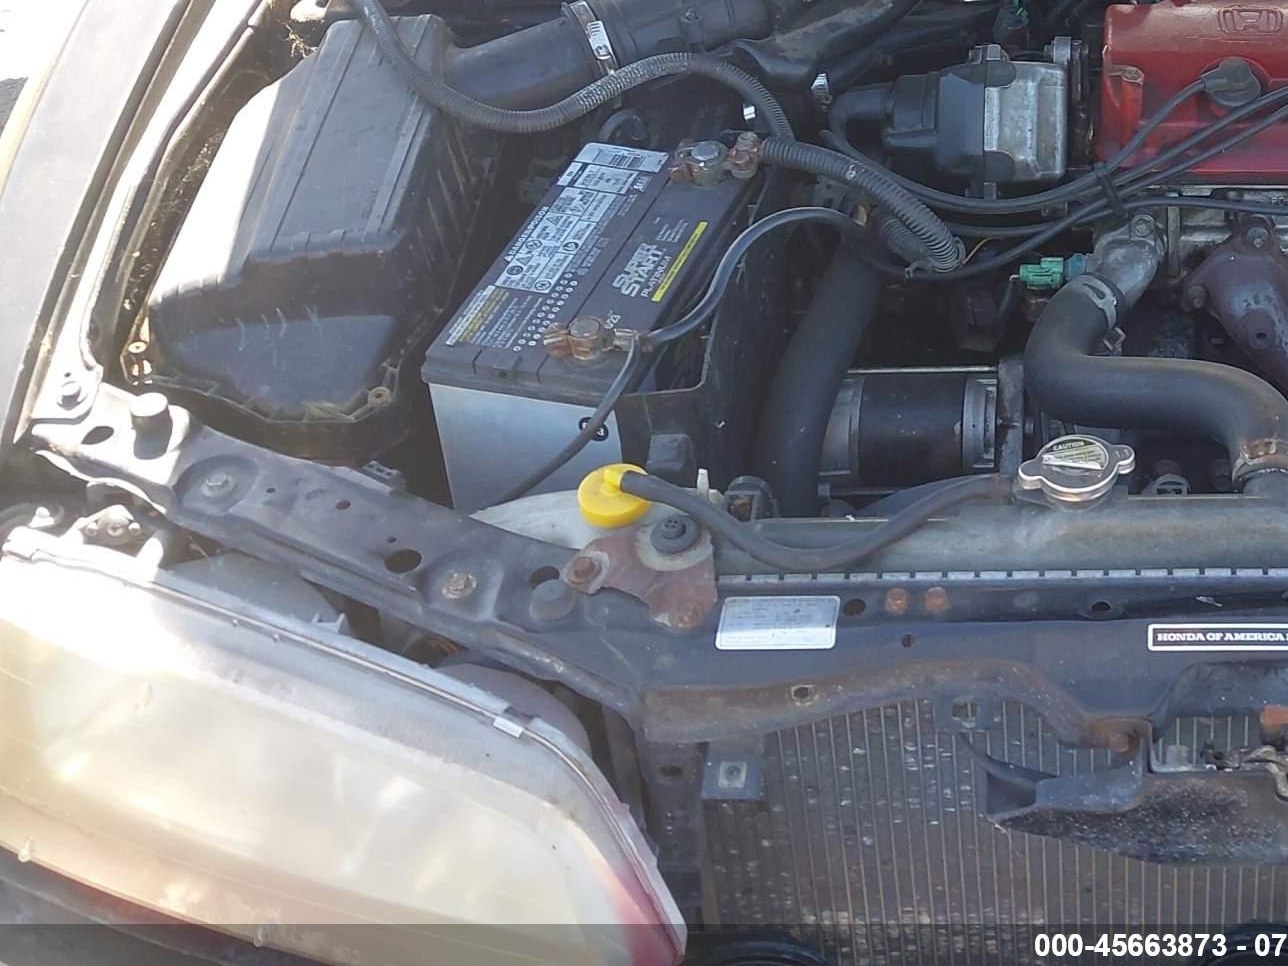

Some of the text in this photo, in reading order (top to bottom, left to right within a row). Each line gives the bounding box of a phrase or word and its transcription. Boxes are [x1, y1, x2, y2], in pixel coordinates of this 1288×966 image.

[612, 242, 652, 289] SUPER
[621, 245, 663, 297] START
[640, 255, 673, 298] PLATINUM
[1052, 441, 1085, 452] CAUTION
[1157, 632, 1206, 642] HONDA
[1206, 632, 1224, 642] OF
[1223, 632, 1285, 642] AMERICA
